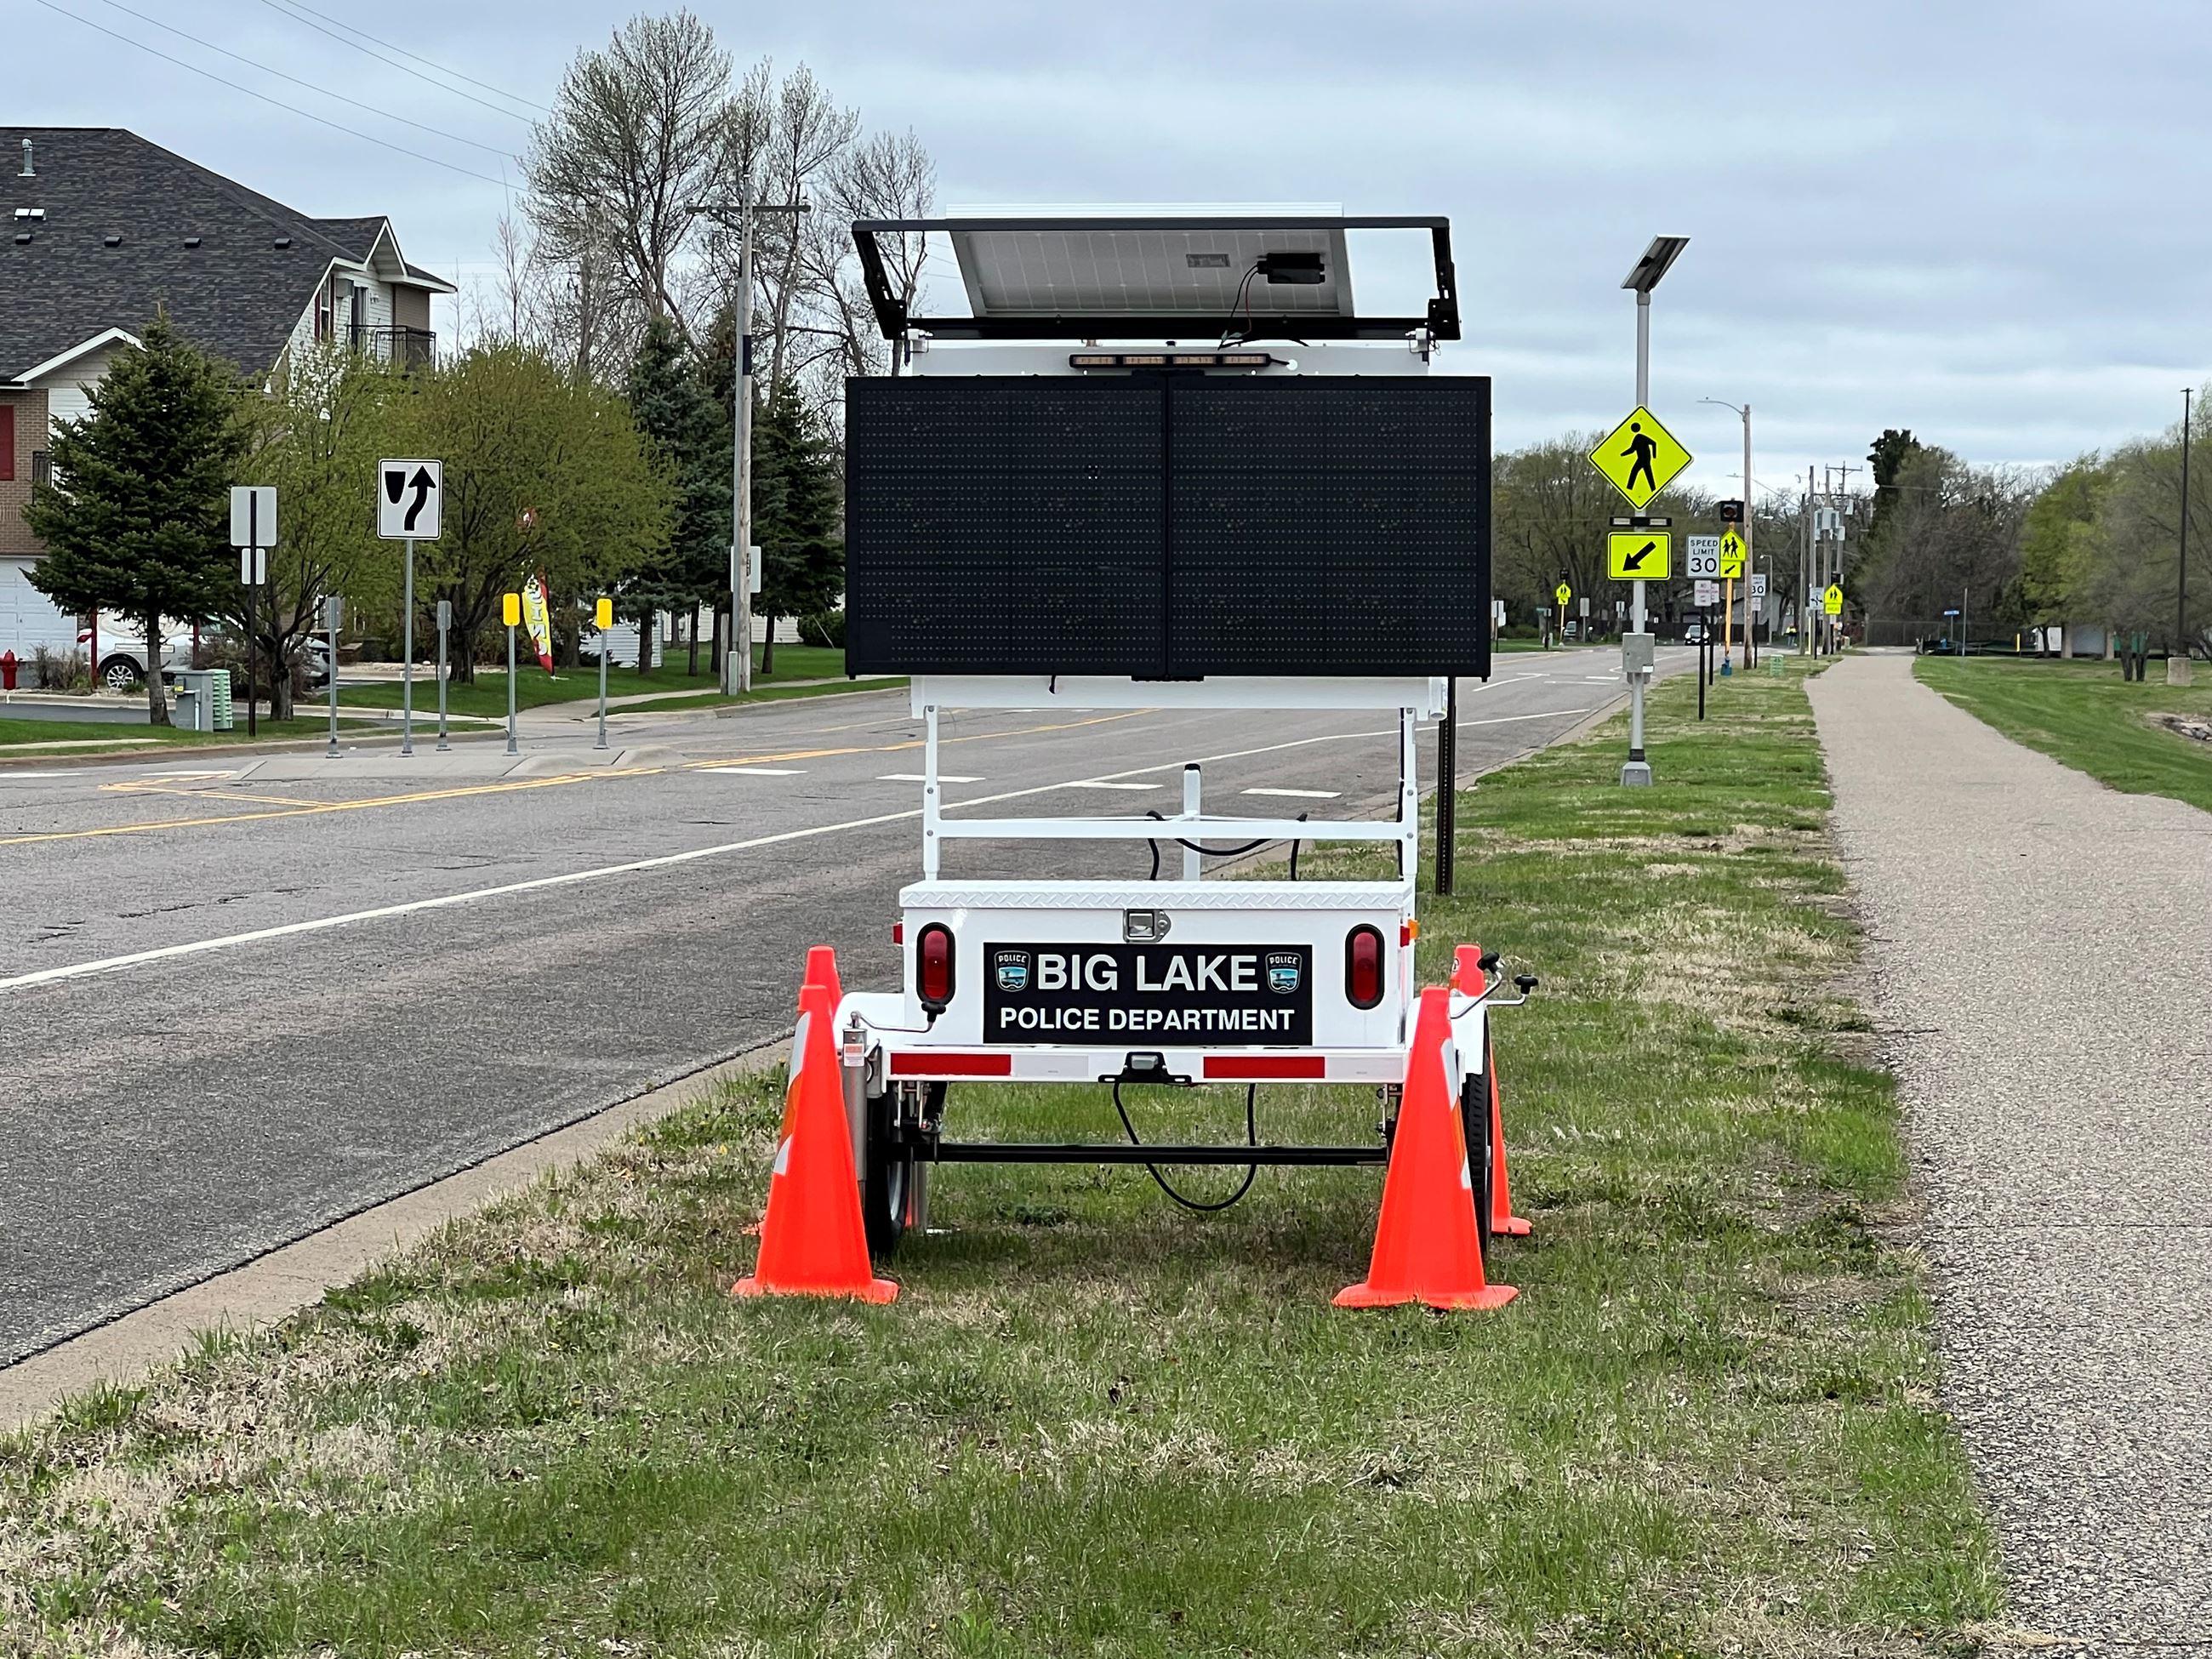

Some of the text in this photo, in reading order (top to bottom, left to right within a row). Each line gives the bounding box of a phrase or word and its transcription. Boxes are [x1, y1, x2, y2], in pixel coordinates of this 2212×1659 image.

[1690, 557, 1717, 573] 30
[998, 954, 1027, 963] POLICE
[1268, 955, 1298, 965] POLICE
[1038, 954, 1258, 991] BIG LAKE
[1001, 1007, 1295, 1030] POLICE DEPARTMENT
